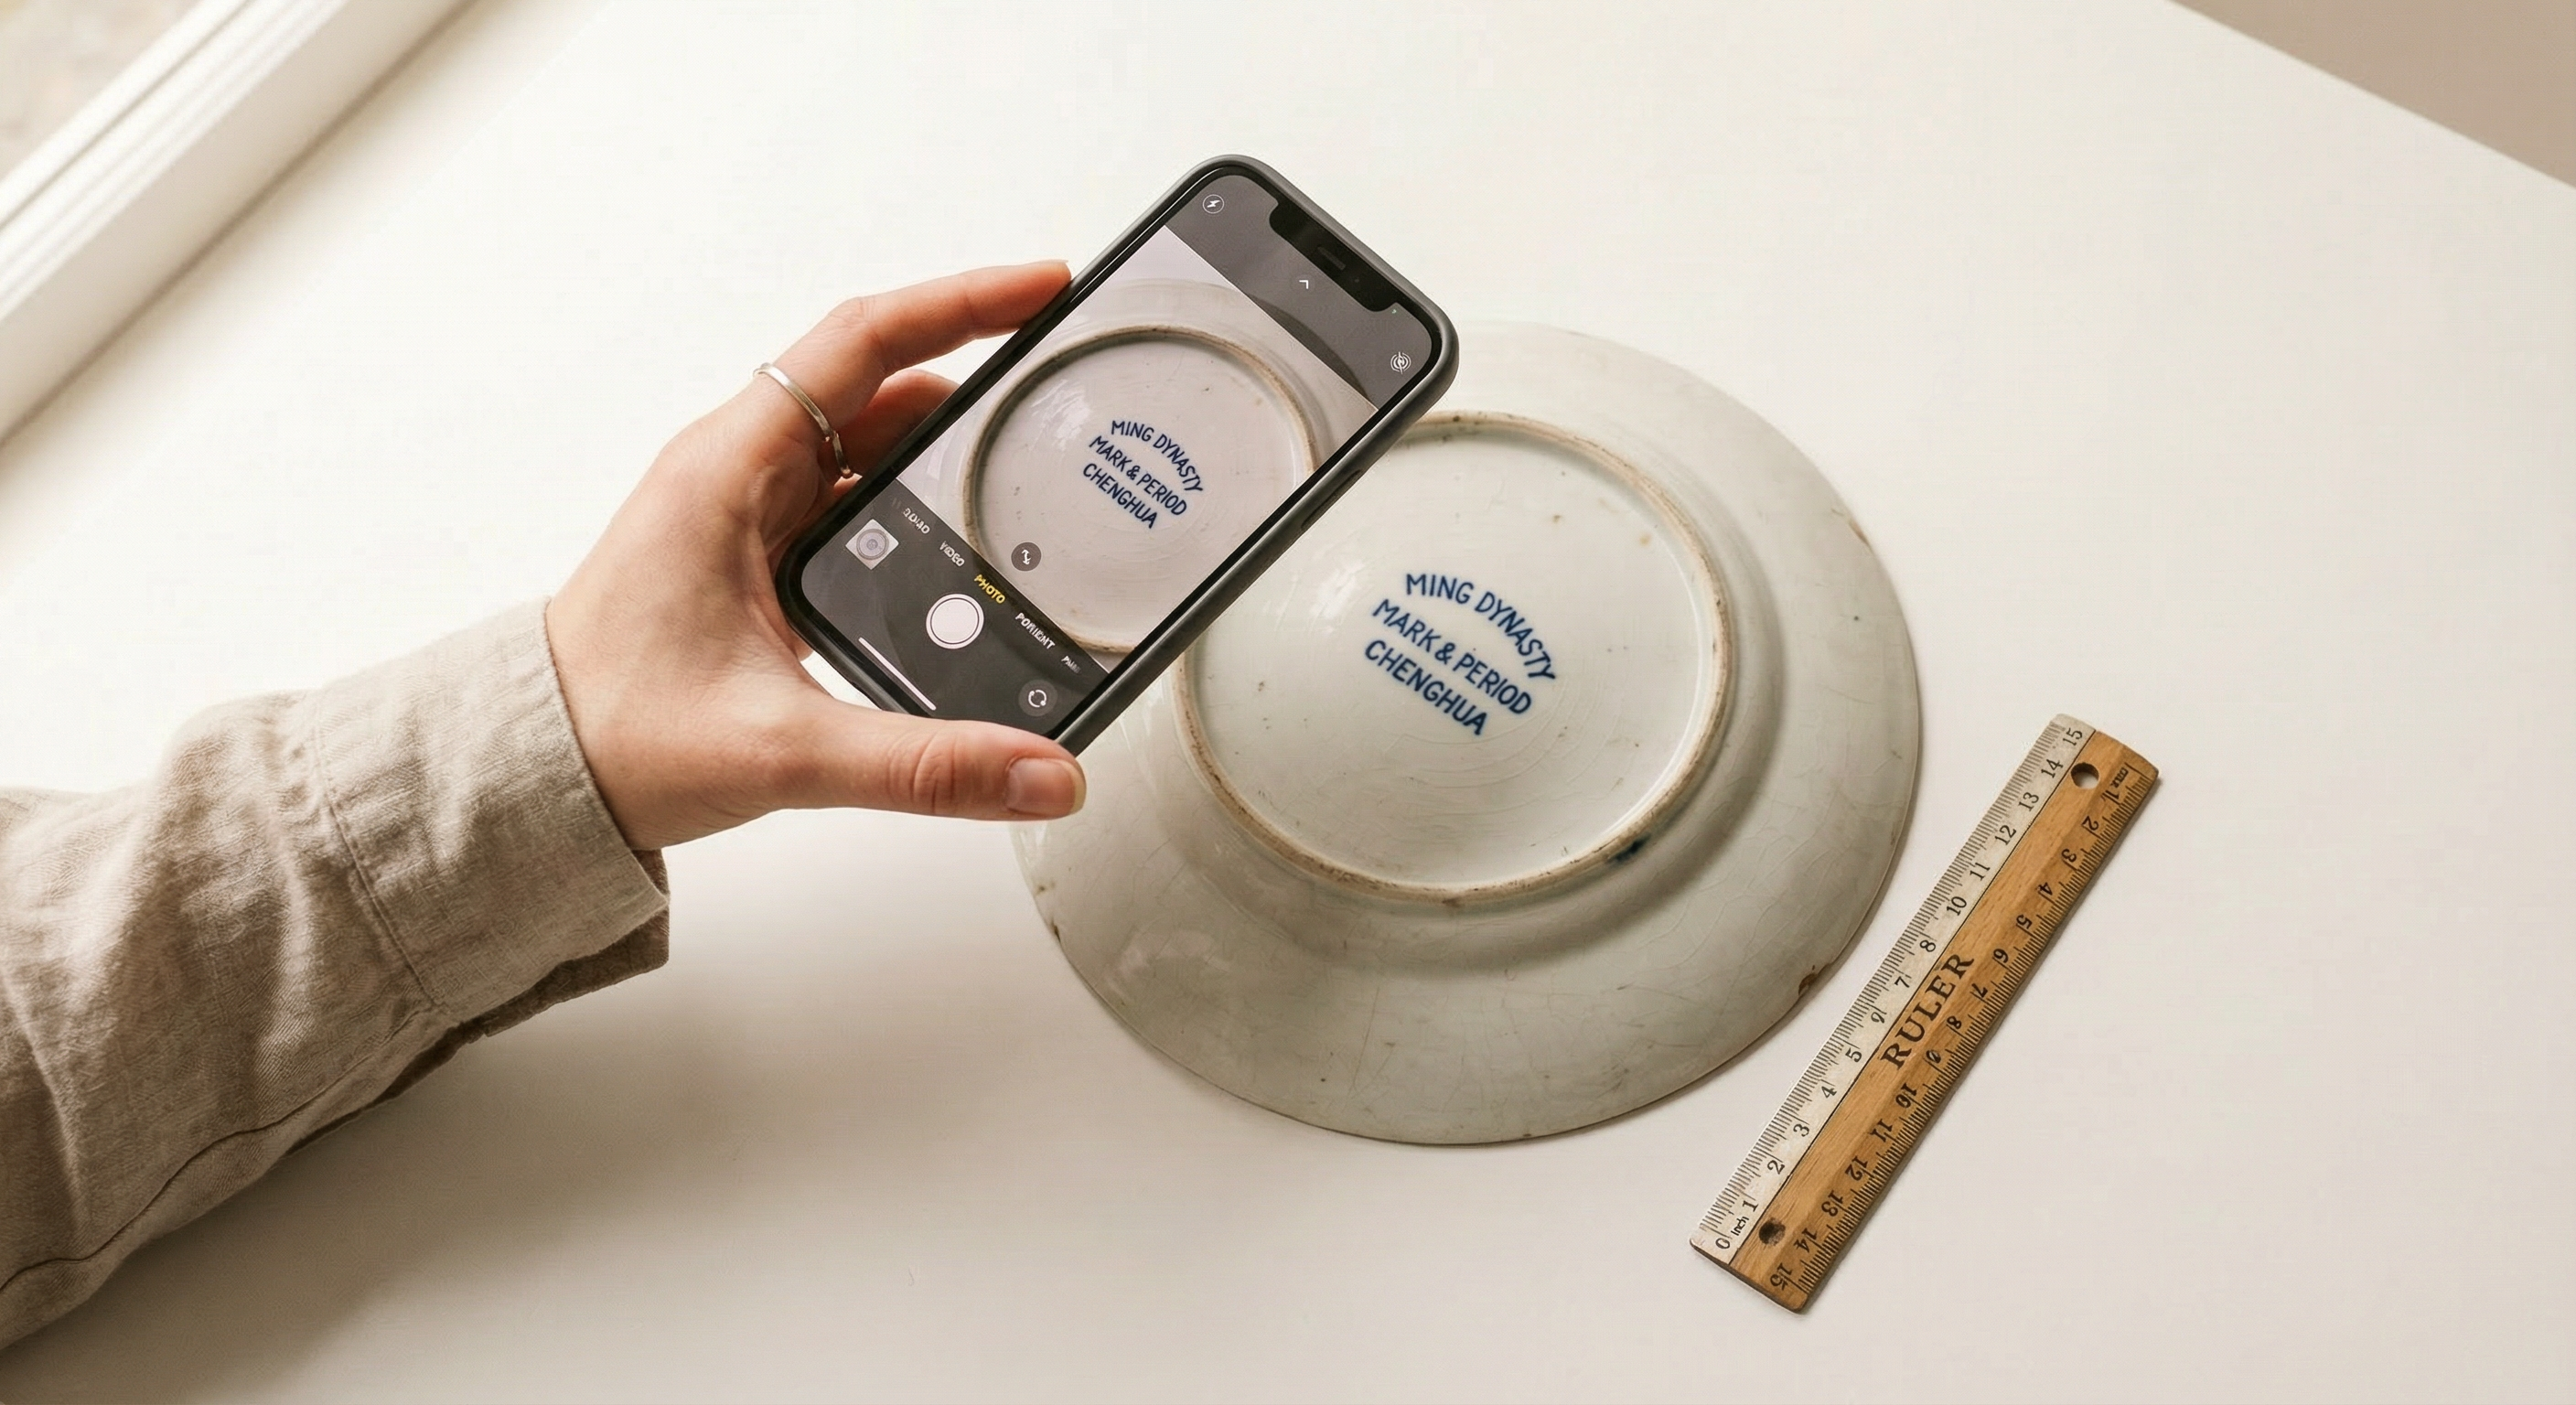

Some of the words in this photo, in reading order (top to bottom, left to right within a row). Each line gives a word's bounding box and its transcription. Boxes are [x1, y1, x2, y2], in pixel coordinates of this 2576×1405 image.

[1111, 420, 1154, 442] MING
[1153, 434, 1204, 492] DYNASTY
[1089, 435, 1132, 472] MARK
[1126, 465, 1141, 480] &
[1136, 473, 1187, 515] PERIOD
[1083, 463, 1158, 529] CHENGHUA
[974, 574, 1005, 604] PHOTO
[1406, 574, 1475, 605] MING
[1474, 591, 1557, 680] DYNASTY
[1372, 598, 1442, 652] MARK
[1434, 642, 1455, 665] &
[1452, 652, 1531, 714] PERIOD
[1364, 639, 1487, 735] CHENGHUA
[2081, 816, 2099, 831] 2
[2061, 848, 2077, 863] 3
[2038, 882, 2054, 896] 4
[2016, 915, 2033, 929] 5
[1993, 949, 2009, 963] 6
[1715, 1238, 1731, 1249] 0
[1766, 1159, 1785, 1174] 2
[1793, 1123, 1810, 1137] 3
[1820, 1085, 1837, 1099] 4
[1845, 1047, 1862, 1063] 5
[1894, 976, 1910, 989] 7
[1919, 939, 1937, 952] 8
[1946, 896, 1968, 916] 10
[1970, 862, 1991, 881] 11
[1994, 824, 2017, 846] 12
[2018, 791, 2040, 812] 13
[2040, 758, 2064, 778] 14
[2062, 727, 2083, 746] 15
[1971, 982, 1989, 998] 7
[1880, 953, 1975, 1070] RULER
[1947, 1015, 1962, 1030] 8
[1845, 1155, 1868, 1181] 12
